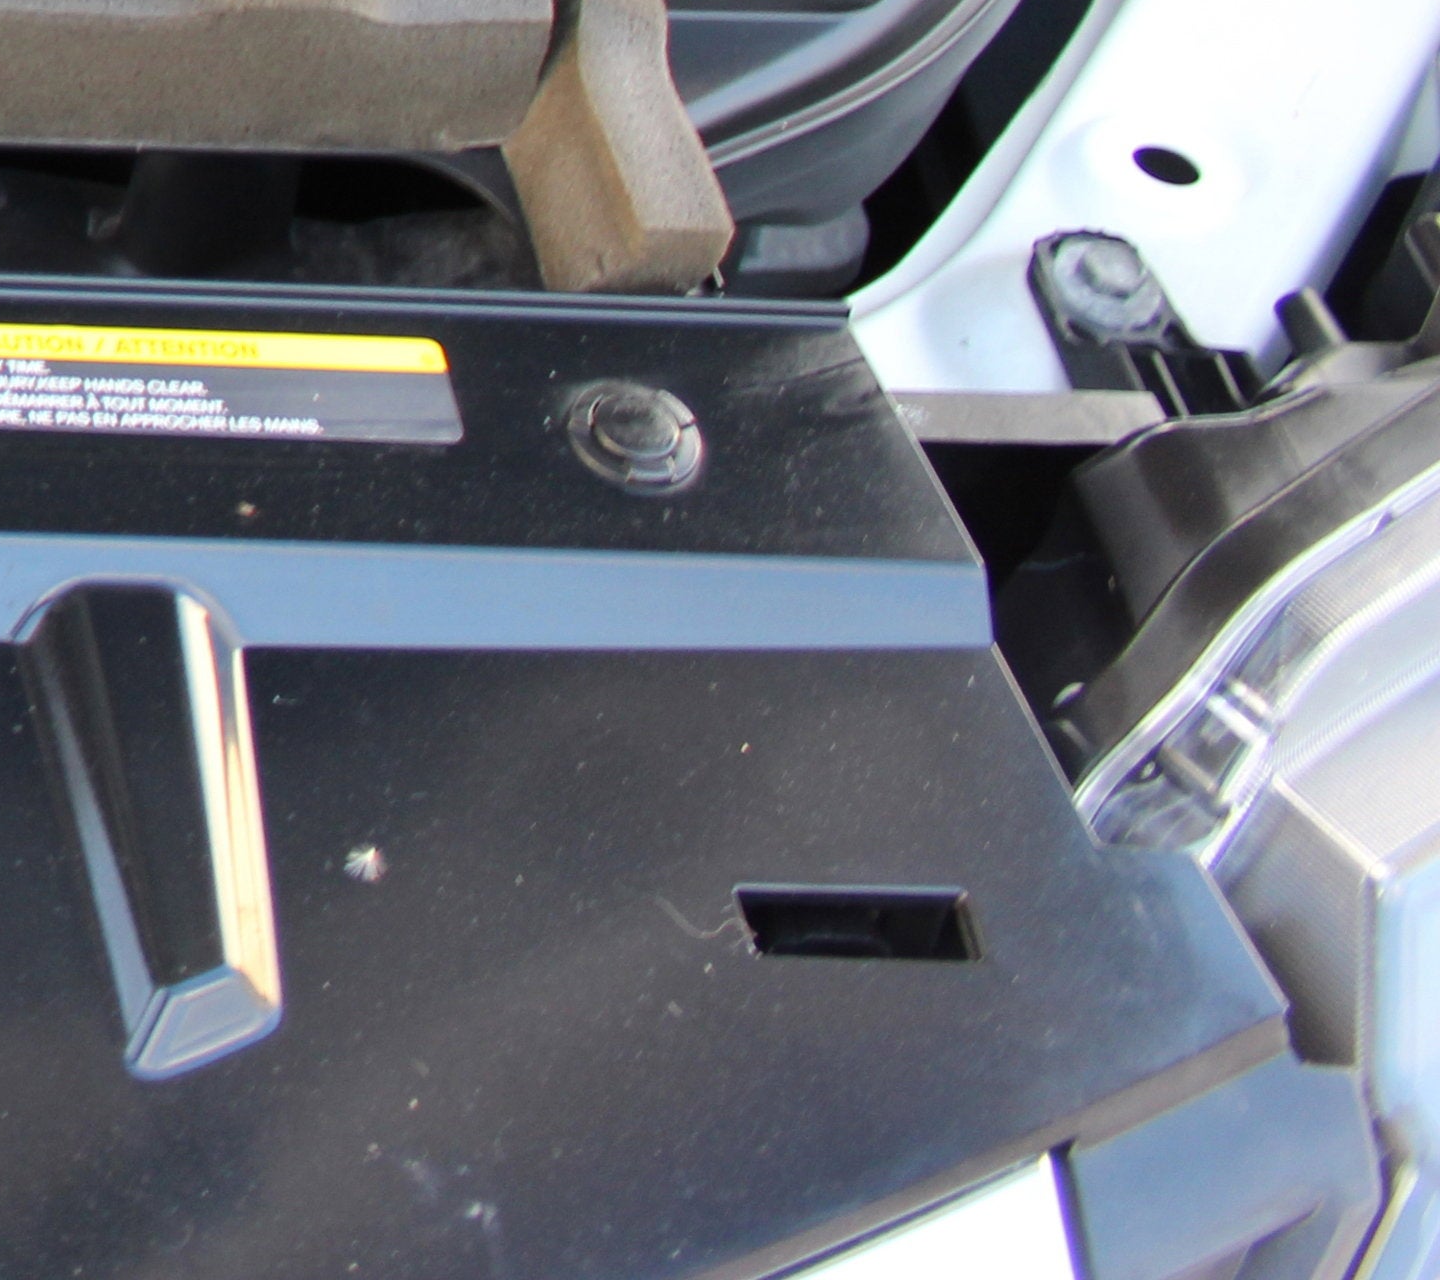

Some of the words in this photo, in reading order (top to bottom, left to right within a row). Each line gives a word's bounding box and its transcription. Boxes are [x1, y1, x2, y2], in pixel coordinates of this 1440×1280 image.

[114, 338, 260, 359] ATTENTION
[38, 376, 81, 391] KEEP
[84, 378, 145, 393] HANDS
[147, 379, 208, 396] CLEAR.
[102, 397, 147, 412] TOUT
[148, 398, 228, 415] MOMENT.
[29, 409, 53, 424] NE
[56, 410, 90, 426] PAS
[93, 414, 117, 429] EN
[121, 415, 228, 432] APPROCHER
[229, 417, 262, 432] LES
[263, 418, 324, 434] MAINS.
